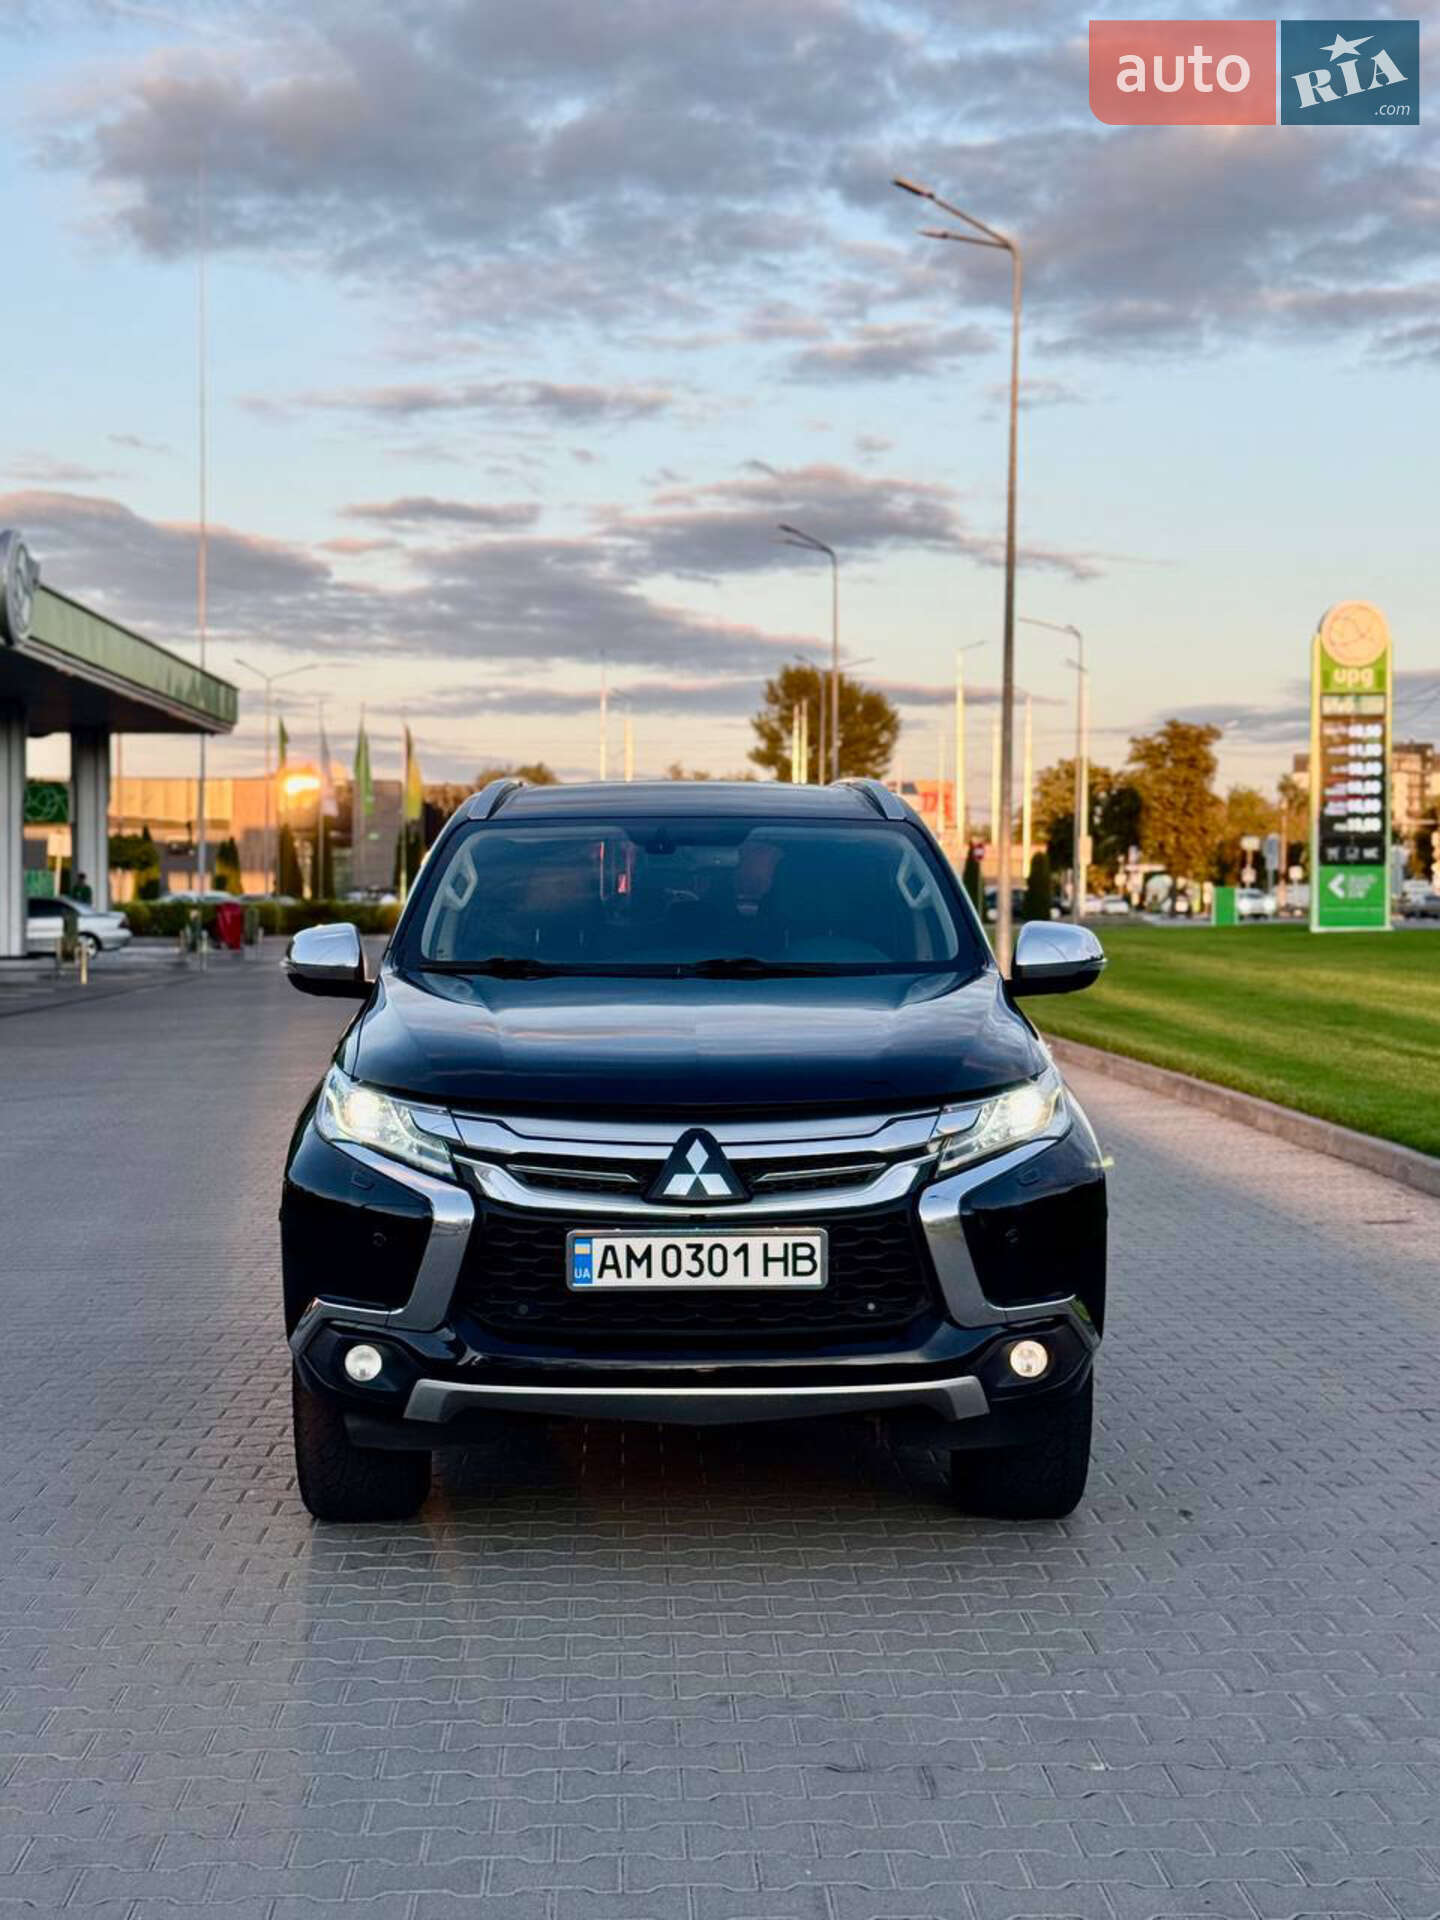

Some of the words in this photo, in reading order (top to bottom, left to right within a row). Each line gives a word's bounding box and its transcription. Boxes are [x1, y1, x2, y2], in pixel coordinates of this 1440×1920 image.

[597, 1244, 652, 1279] AM
[661, 1242, 749, 1278] 0301
[762, 1242, 818, 1277] HB
[574, 1267, 591, 1279] UA
